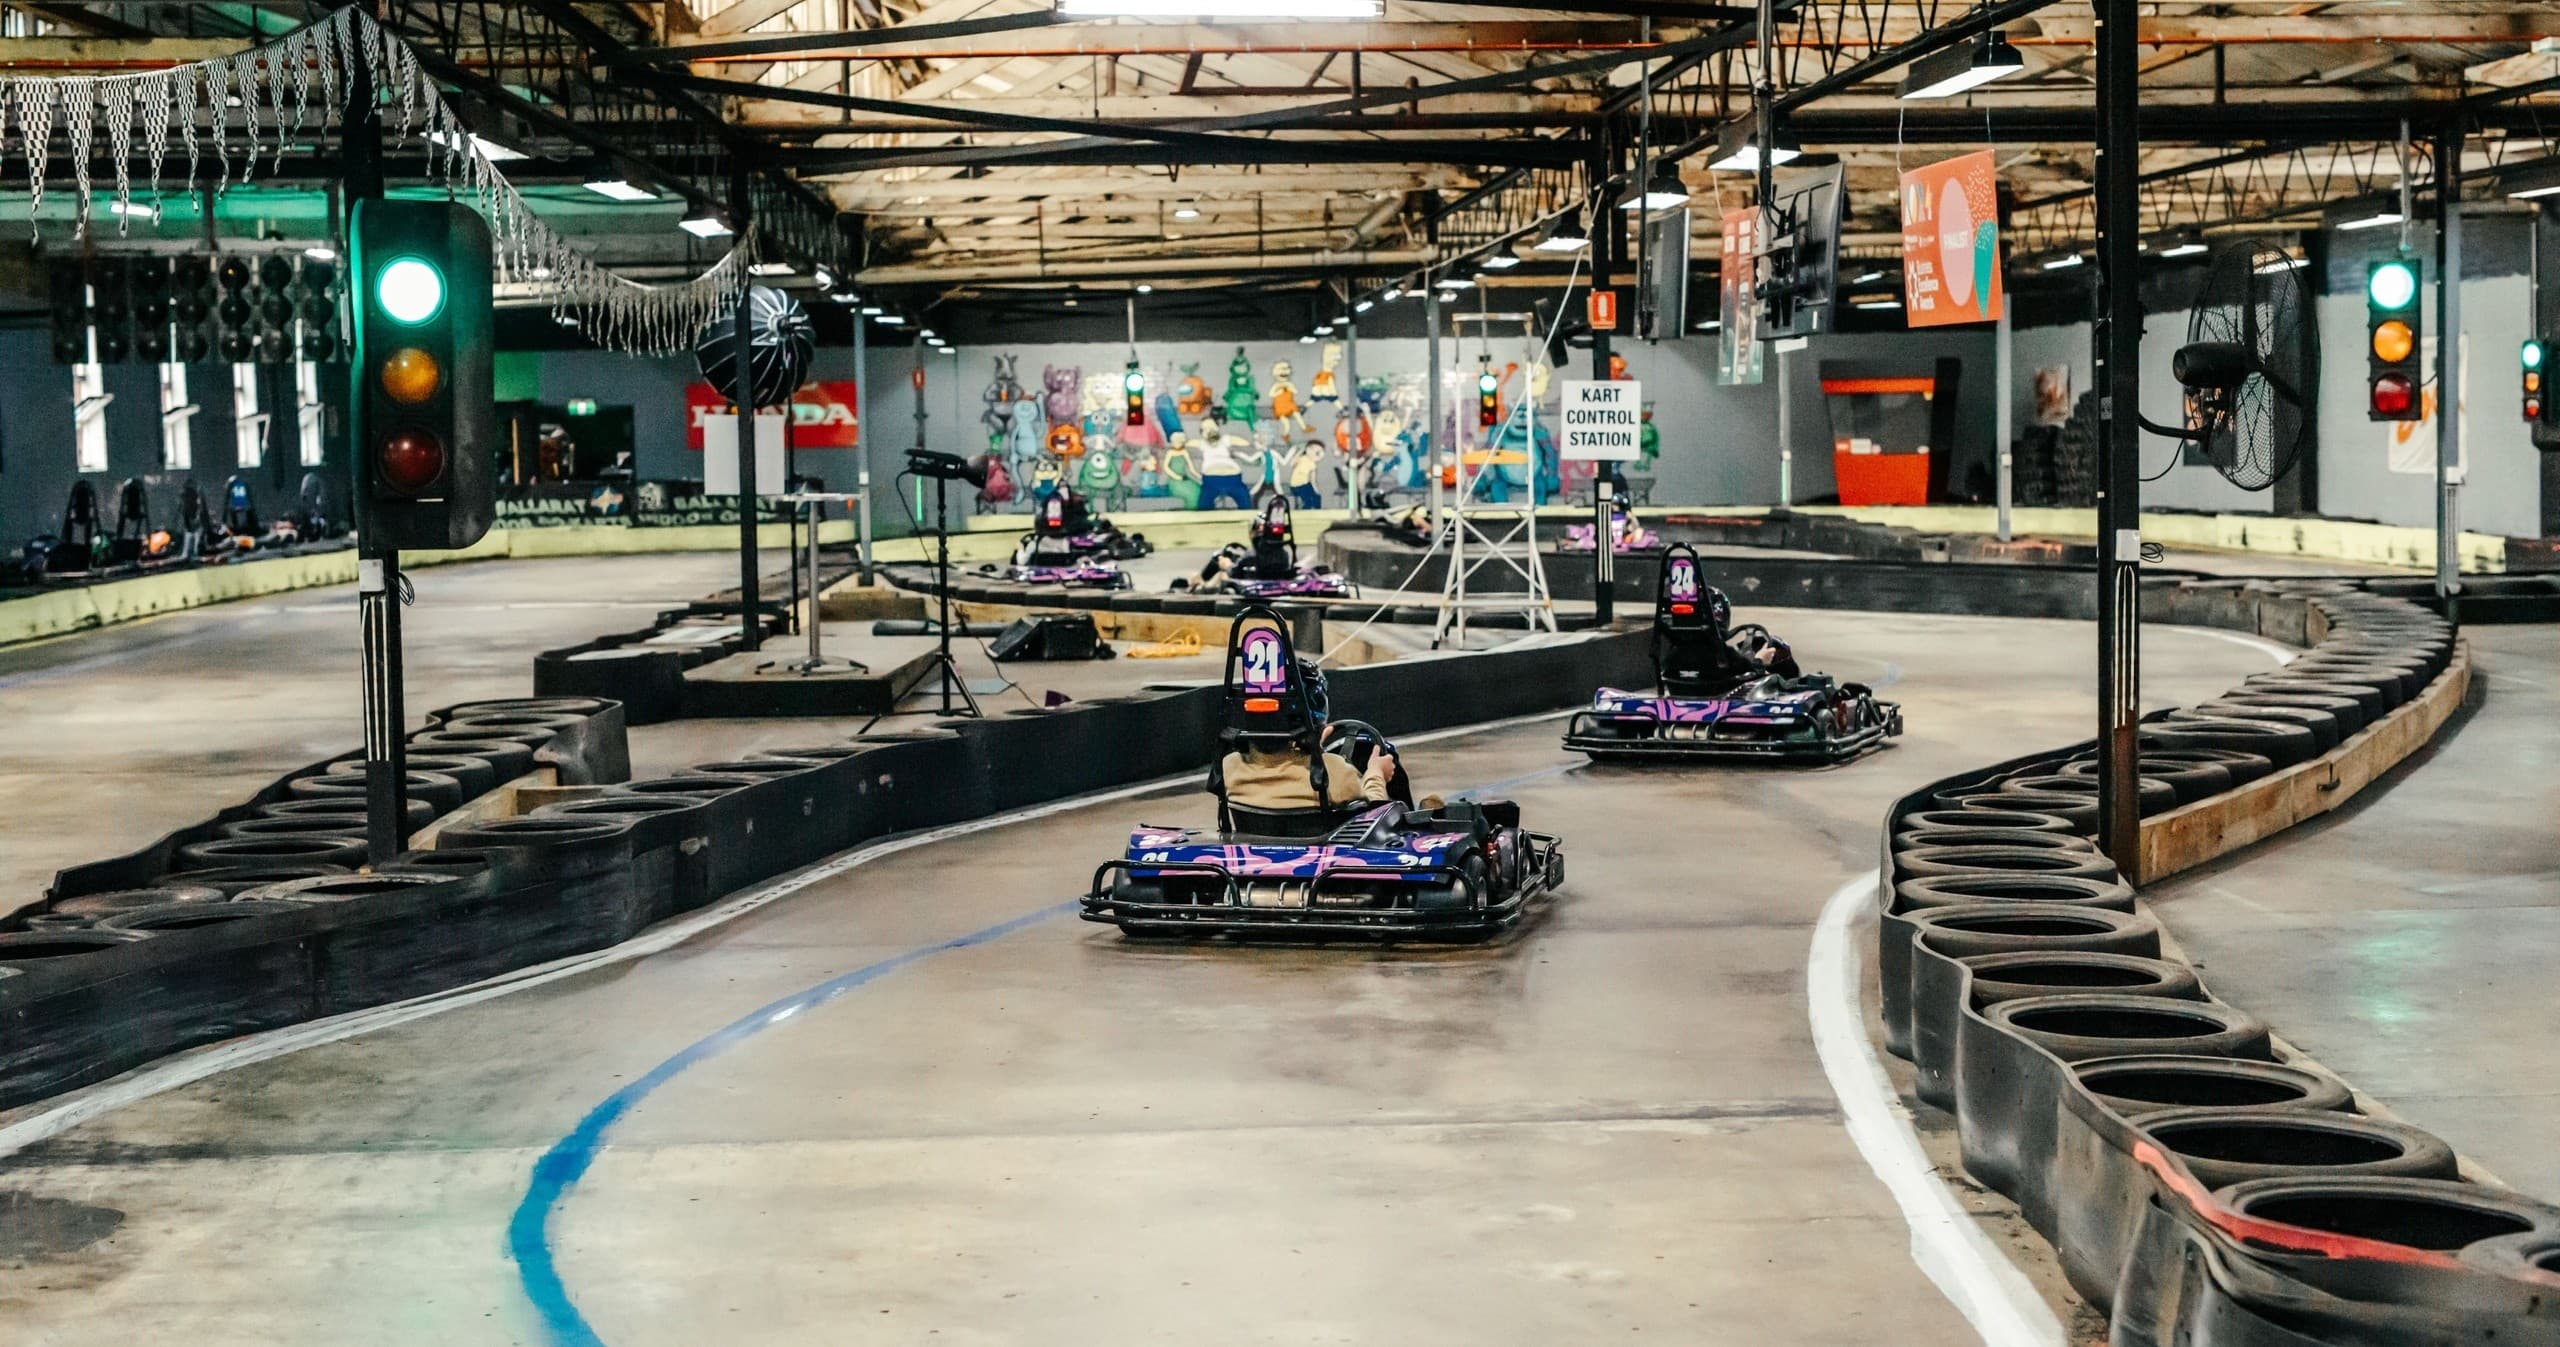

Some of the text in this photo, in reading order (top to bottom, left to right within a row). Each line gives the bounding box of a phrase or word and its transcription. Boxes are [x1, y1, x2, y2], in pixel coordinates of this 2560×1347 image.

[1582, 388, 1621, 402] KART
[1567, 409, 1636, 425] CONTROL
[1570, 432, 1631, 446] STATION
[1671, 565, 1694, 595] 24
[1248, 640, 1278, 682] 21
